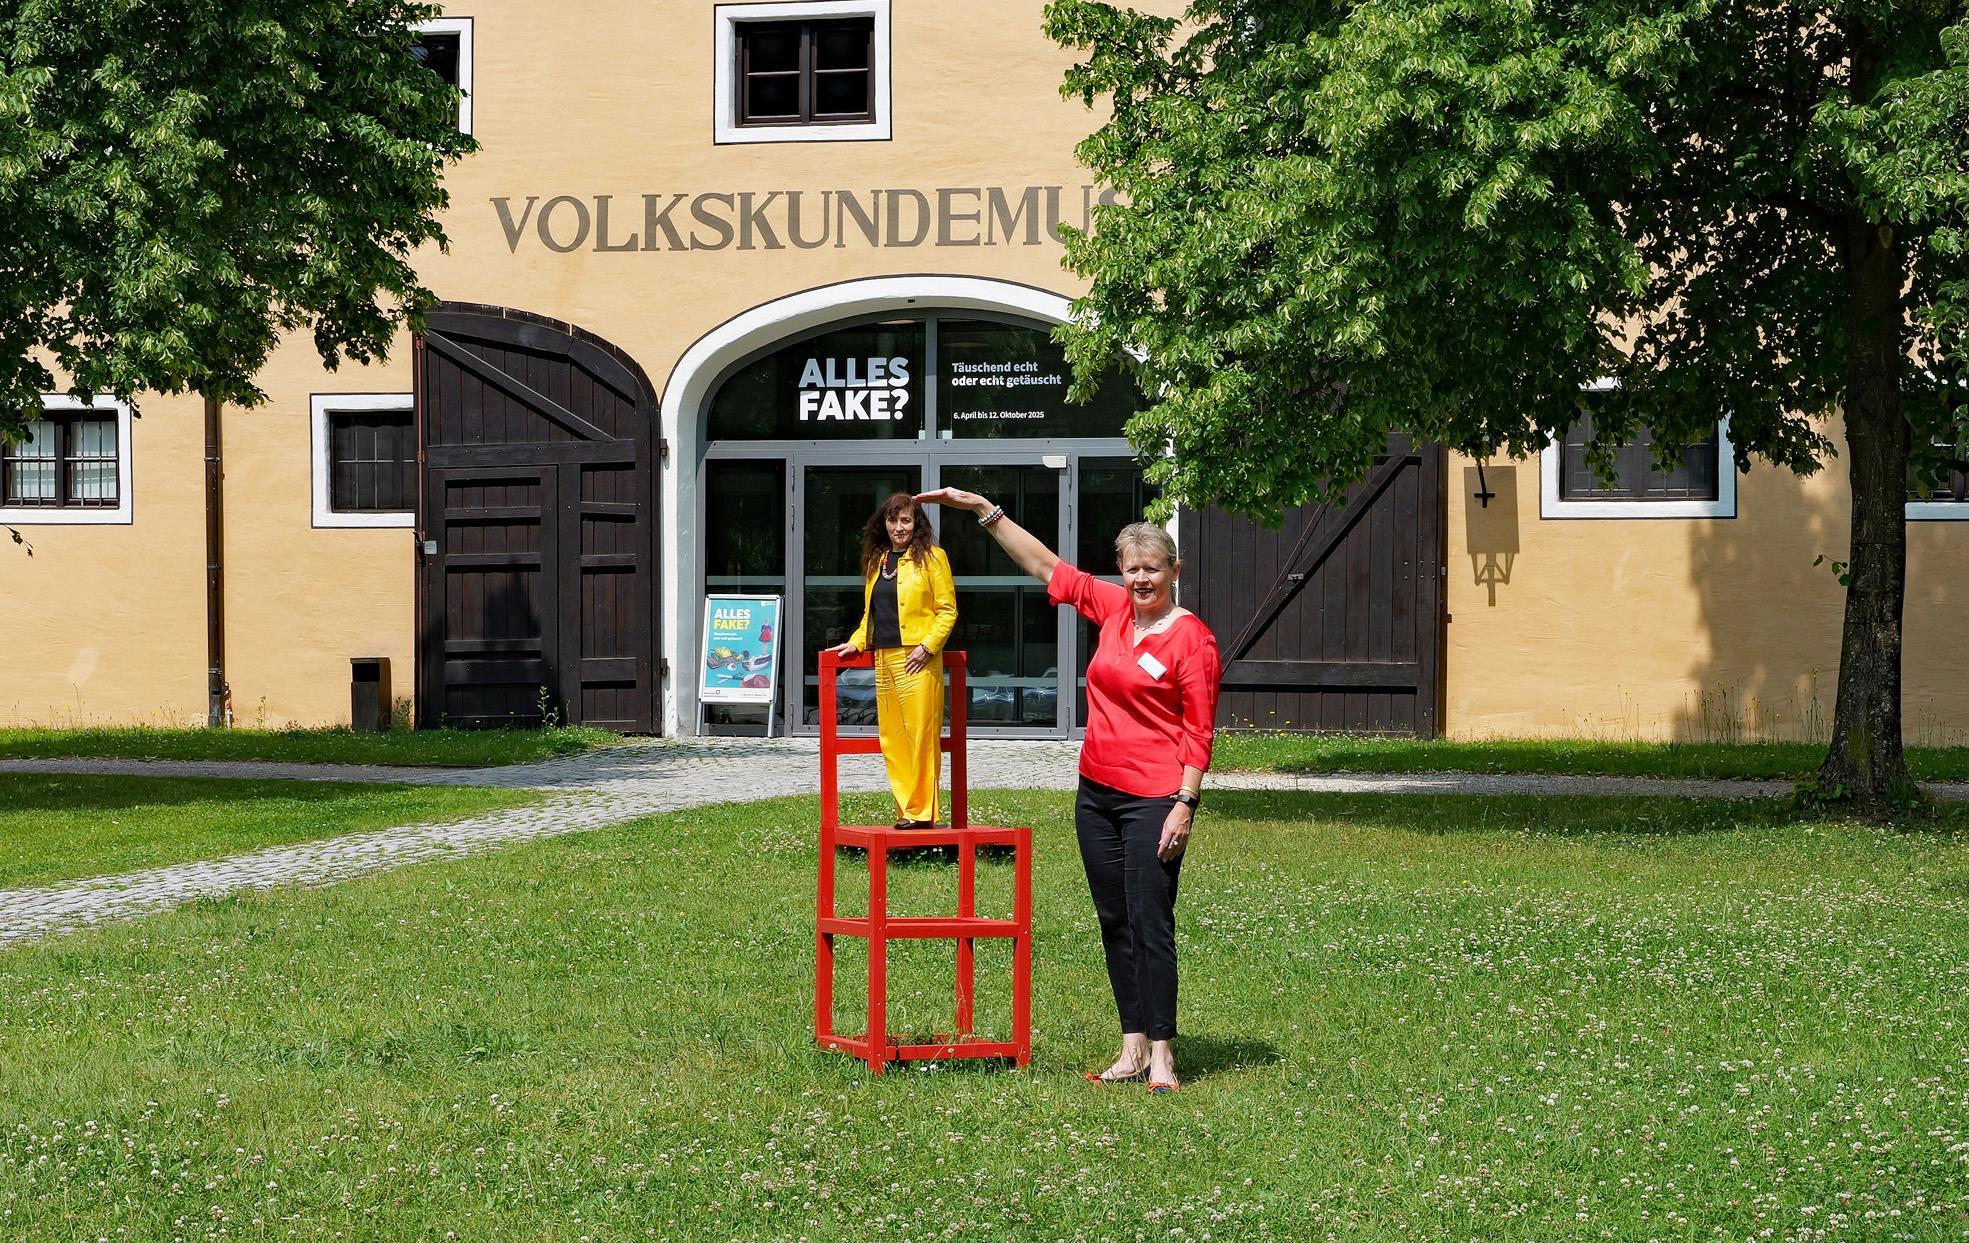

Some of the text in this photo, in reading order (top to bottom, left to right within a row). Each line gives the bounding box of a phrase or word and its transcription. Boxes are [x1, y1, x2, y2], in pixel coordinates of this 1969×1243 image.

[798, 357, 910, 388] ALLES
[951, 361, 1038, 373] Täuschend echt
[951, 374, 1062, 388] oder echt getäuscht
[799, 388, 910, 420] FAKE?
[960, 411, 977, 420] April
[977, 411, 988, 419] bis
[988, 411, 999, 419] 12.
[999, 411, 1027, 419] Oktober
[1028, 411, 1045, 419] 2025
[714, 608, 751, 619] ALLES
[713, 619, 750, 630] FAKE?
